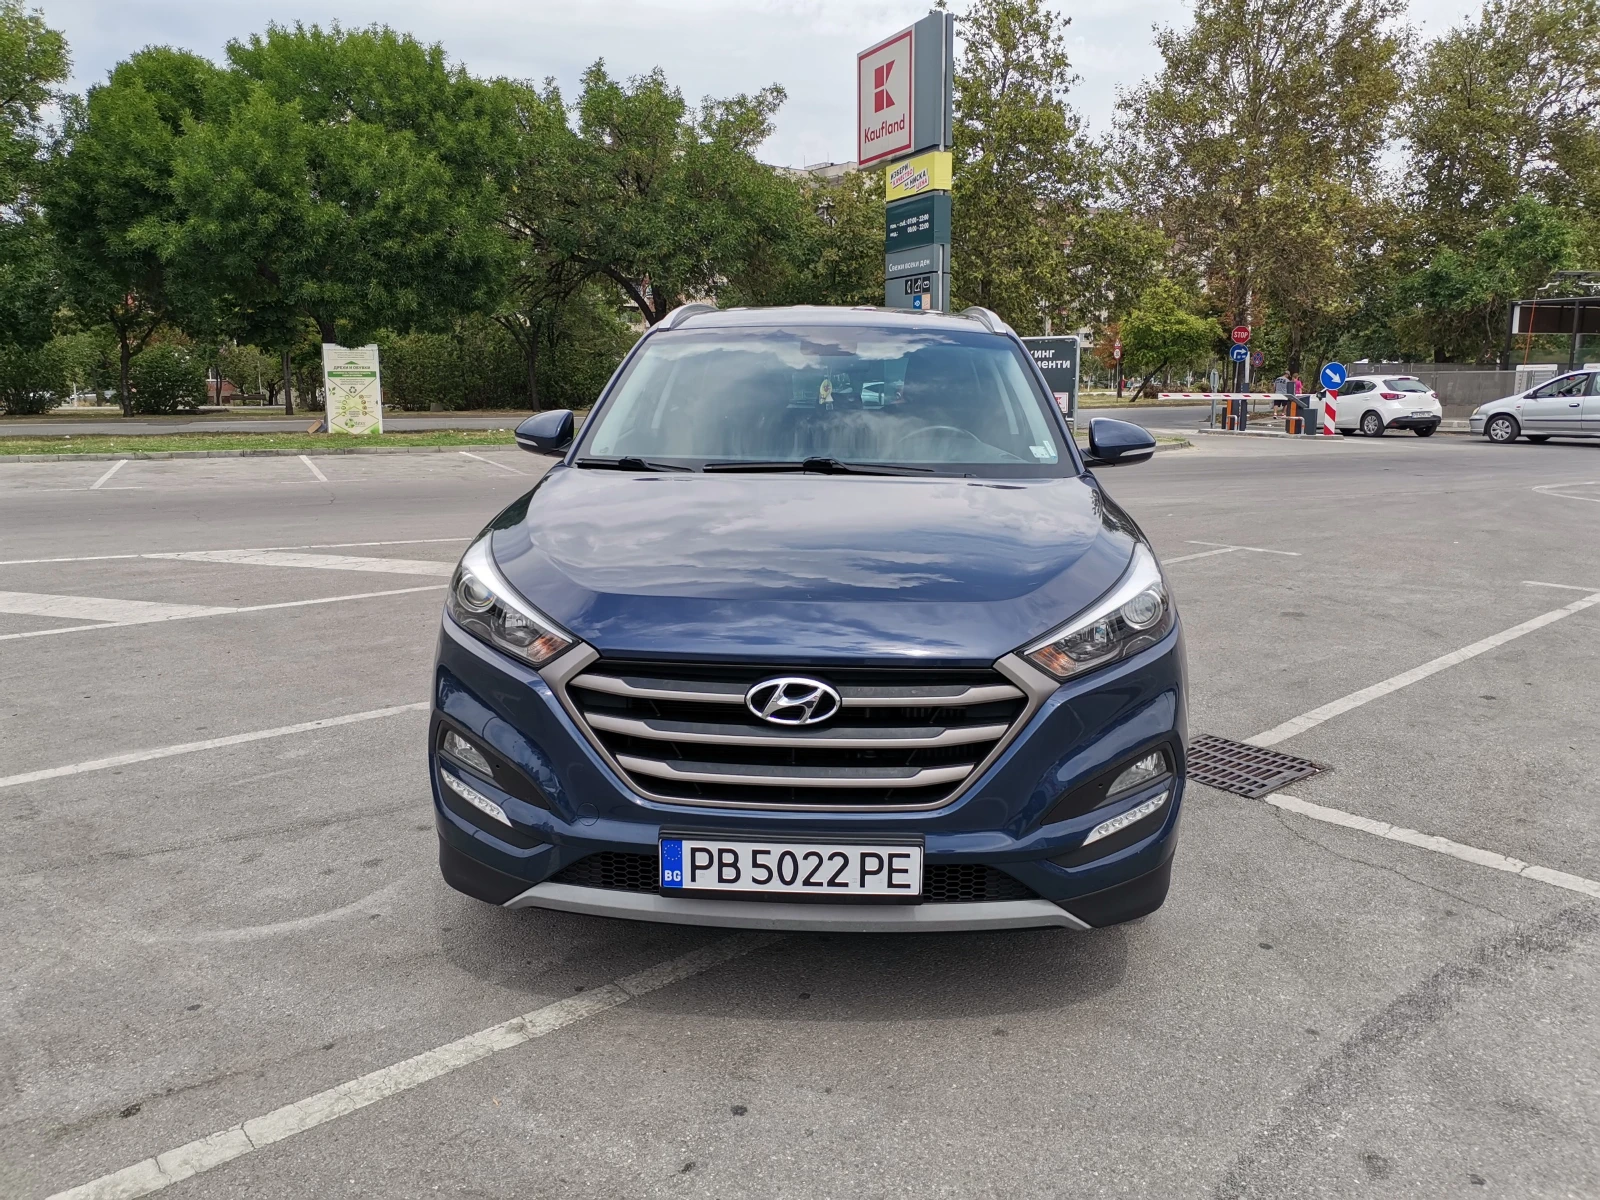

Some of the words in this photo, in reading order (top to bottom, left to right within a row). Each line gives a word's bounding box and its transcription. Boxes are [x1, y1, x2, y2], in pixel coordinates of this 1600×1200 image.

[864, 113, 905, 144] Kaufland
[890, 162, 909, 181] ИЗБЕРИ
[909, 170, 926, 186] НИСКА
[919, 259, 930, 268] ден
[1233, 331, 1249, 339] STOP
[1030, 349, 1055, 358] инг
[690, 846, 741, 884] PB
[751, 849, 850, 888] 5022
[859, 851, 912, 889] PE
[664, 870, 681, 882] BG
